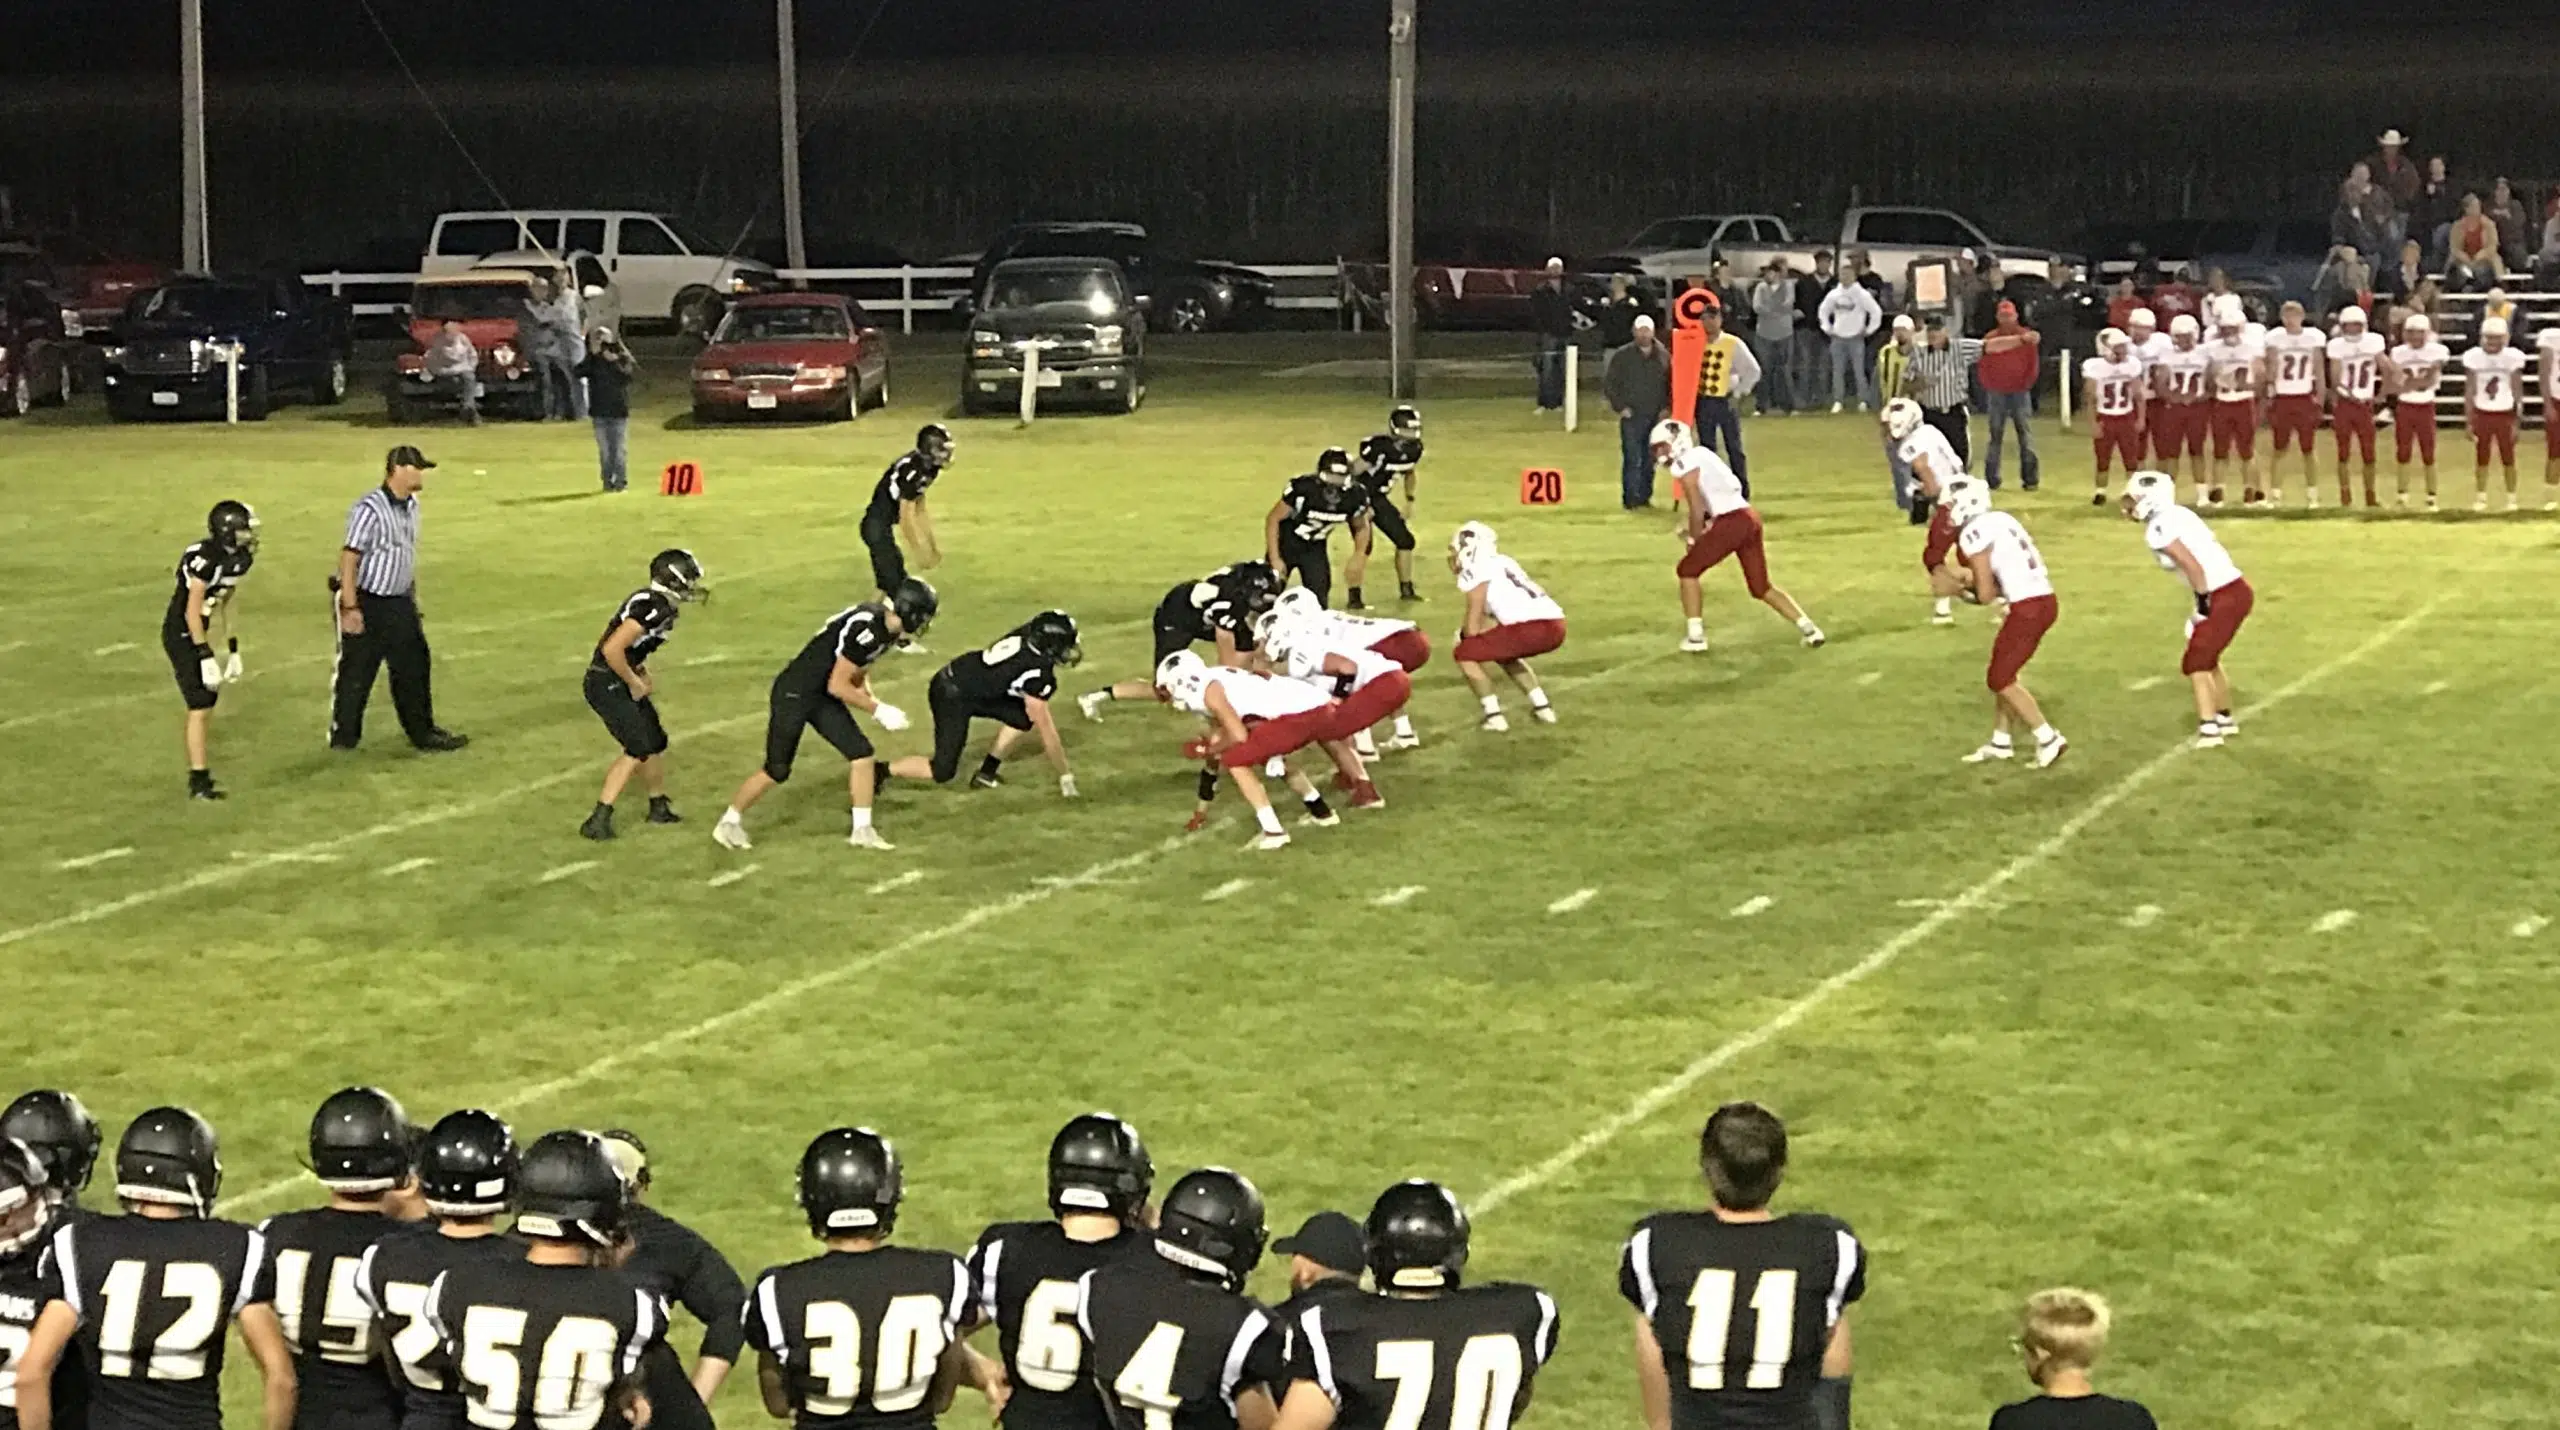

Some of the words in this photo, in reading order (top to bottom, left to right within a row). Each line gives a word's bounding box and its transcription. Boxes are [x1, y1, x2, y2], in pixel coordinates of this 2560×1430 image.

[667, 464, 694, 496] 10
[1528, 471, 1561, 502] 20
[99, 1260, 222, 1379] 12
[274, 1248, 373, 1364] 15
[804, 1294, 944, 1416] 30
[1016, 1279, 1080, 1392] 6
[1687, 1268, 1797, 1390] 11
[460, 1305, 618, 1430] 50
[1114, 1321, 1184, 1430] 4
[1375, 1333, 1522, 1430] 70
